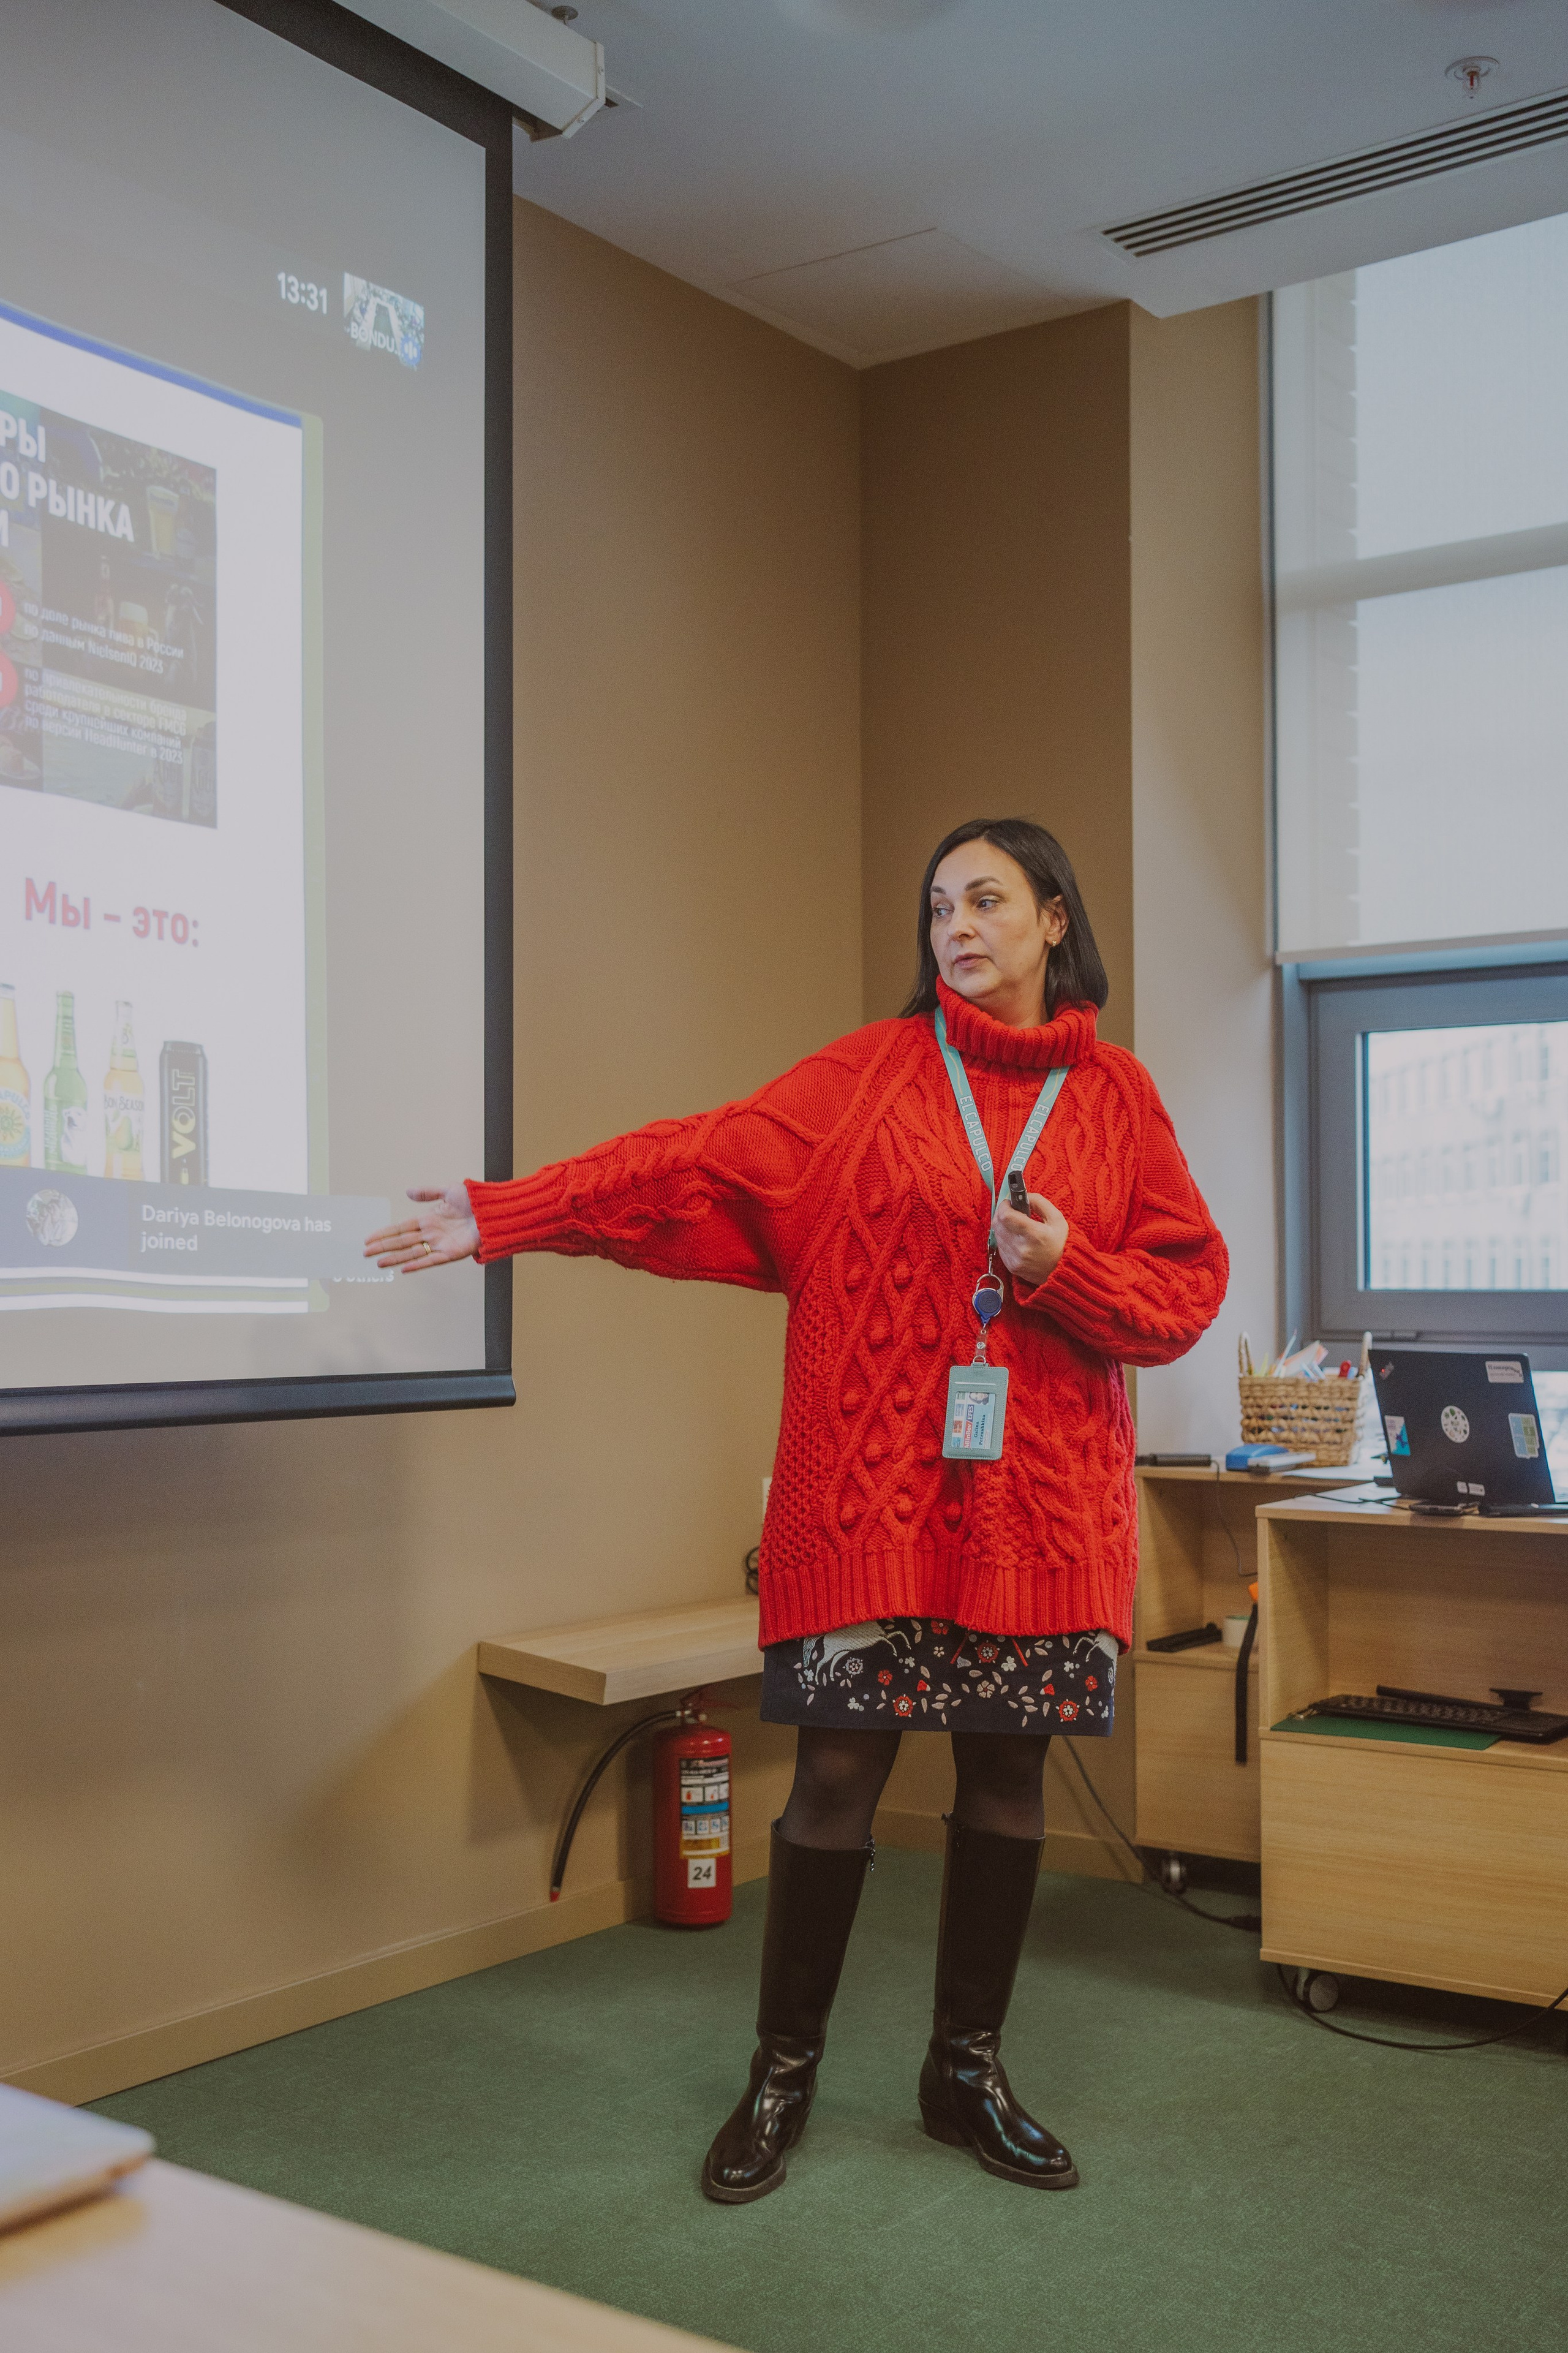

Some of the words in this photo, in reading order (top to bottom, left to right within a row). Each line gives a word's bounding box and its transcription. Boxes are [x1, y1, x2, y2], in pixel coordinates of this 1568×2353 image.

[277, 271, 327, 314] 13:31
[28, 470, 135, 542] РЫНКА
[24, 602, 39, 616] по
[42, 608, 69, 625] доле
[72, 618, 106, 637] рынка
[108, 629, 134, 645] пива
[137, 638, 144, 648] в
[147, 636, 184, 659] России
[24, 624, 39, 636] по
[42, 629, 85, 650] данным
[140, 655, 164, 673] 2023
[24, 668, 39, 681] по
[149, 700, 187, 720] бренда
[24, 716, 39, 728] по
[42, 719, 81, 738] версии
[85, 727, 147, 755] HeadHunter
[150, 749, 157, 758] в
[160, 747, 183, 764] 2023
[25, 700, 59, 717] среди
[131, 730, 181, 749] компаний
[113, 709, 156, 728] секторе
[159, 717, 186, 736] FMCG
[25, 877, 90, 930] Мы
[132, 906, 199, 948] это:
[171, 1069, 196, 1159] VOLT
[140, 1231, 198, 1253] joined
[141, 1204, 199, 1228] Dariya
[204, 1210, 301, 1233] Belonogova
[304, 1216, 332, 1232] has
[693, 1866, 711, 1881] 24
